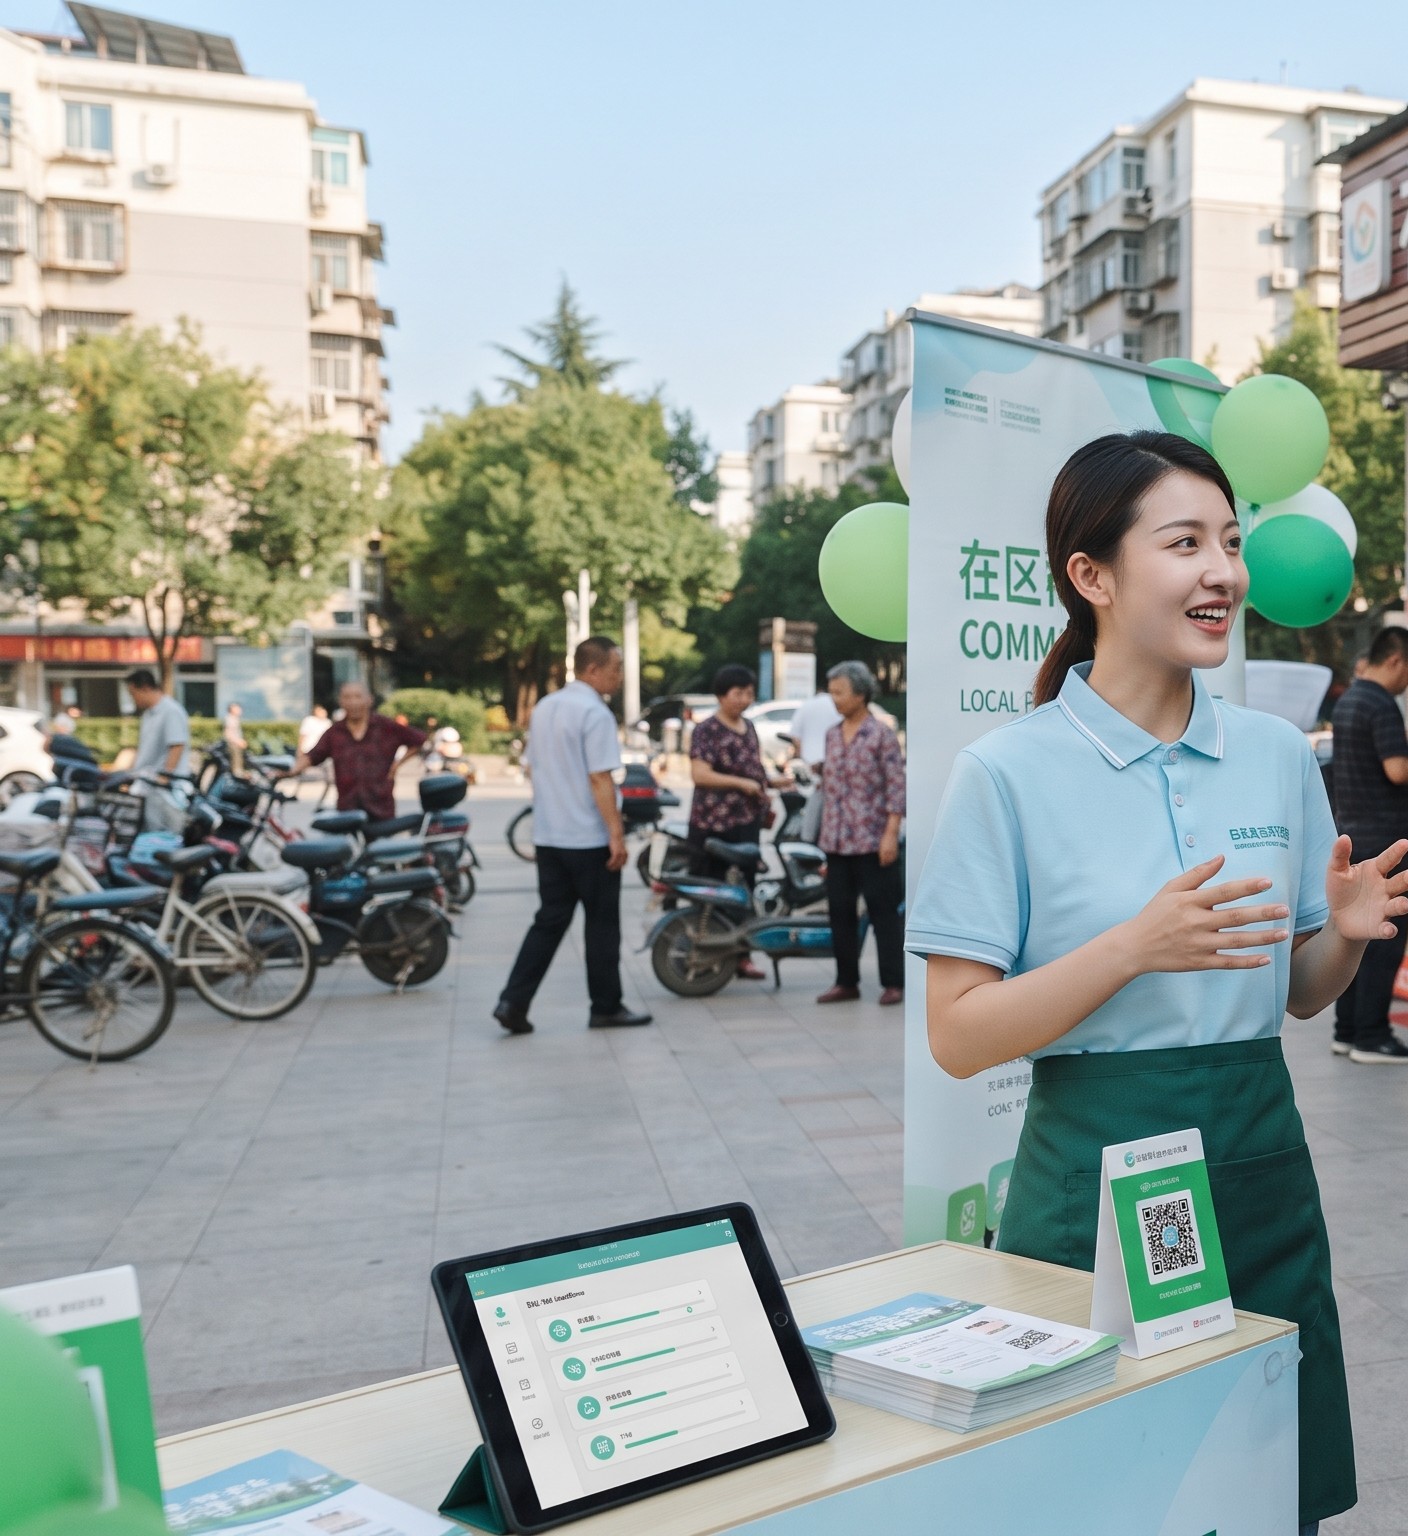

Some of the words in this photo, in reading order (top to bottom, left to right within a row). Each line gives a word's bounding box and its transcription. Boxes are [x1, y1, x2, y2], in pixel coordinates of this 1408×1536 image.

[959, 538, 1057, 608] 在区
[960, 618, 1064, 662] COMM
[960, 688, 1019, 713] LOCAL
